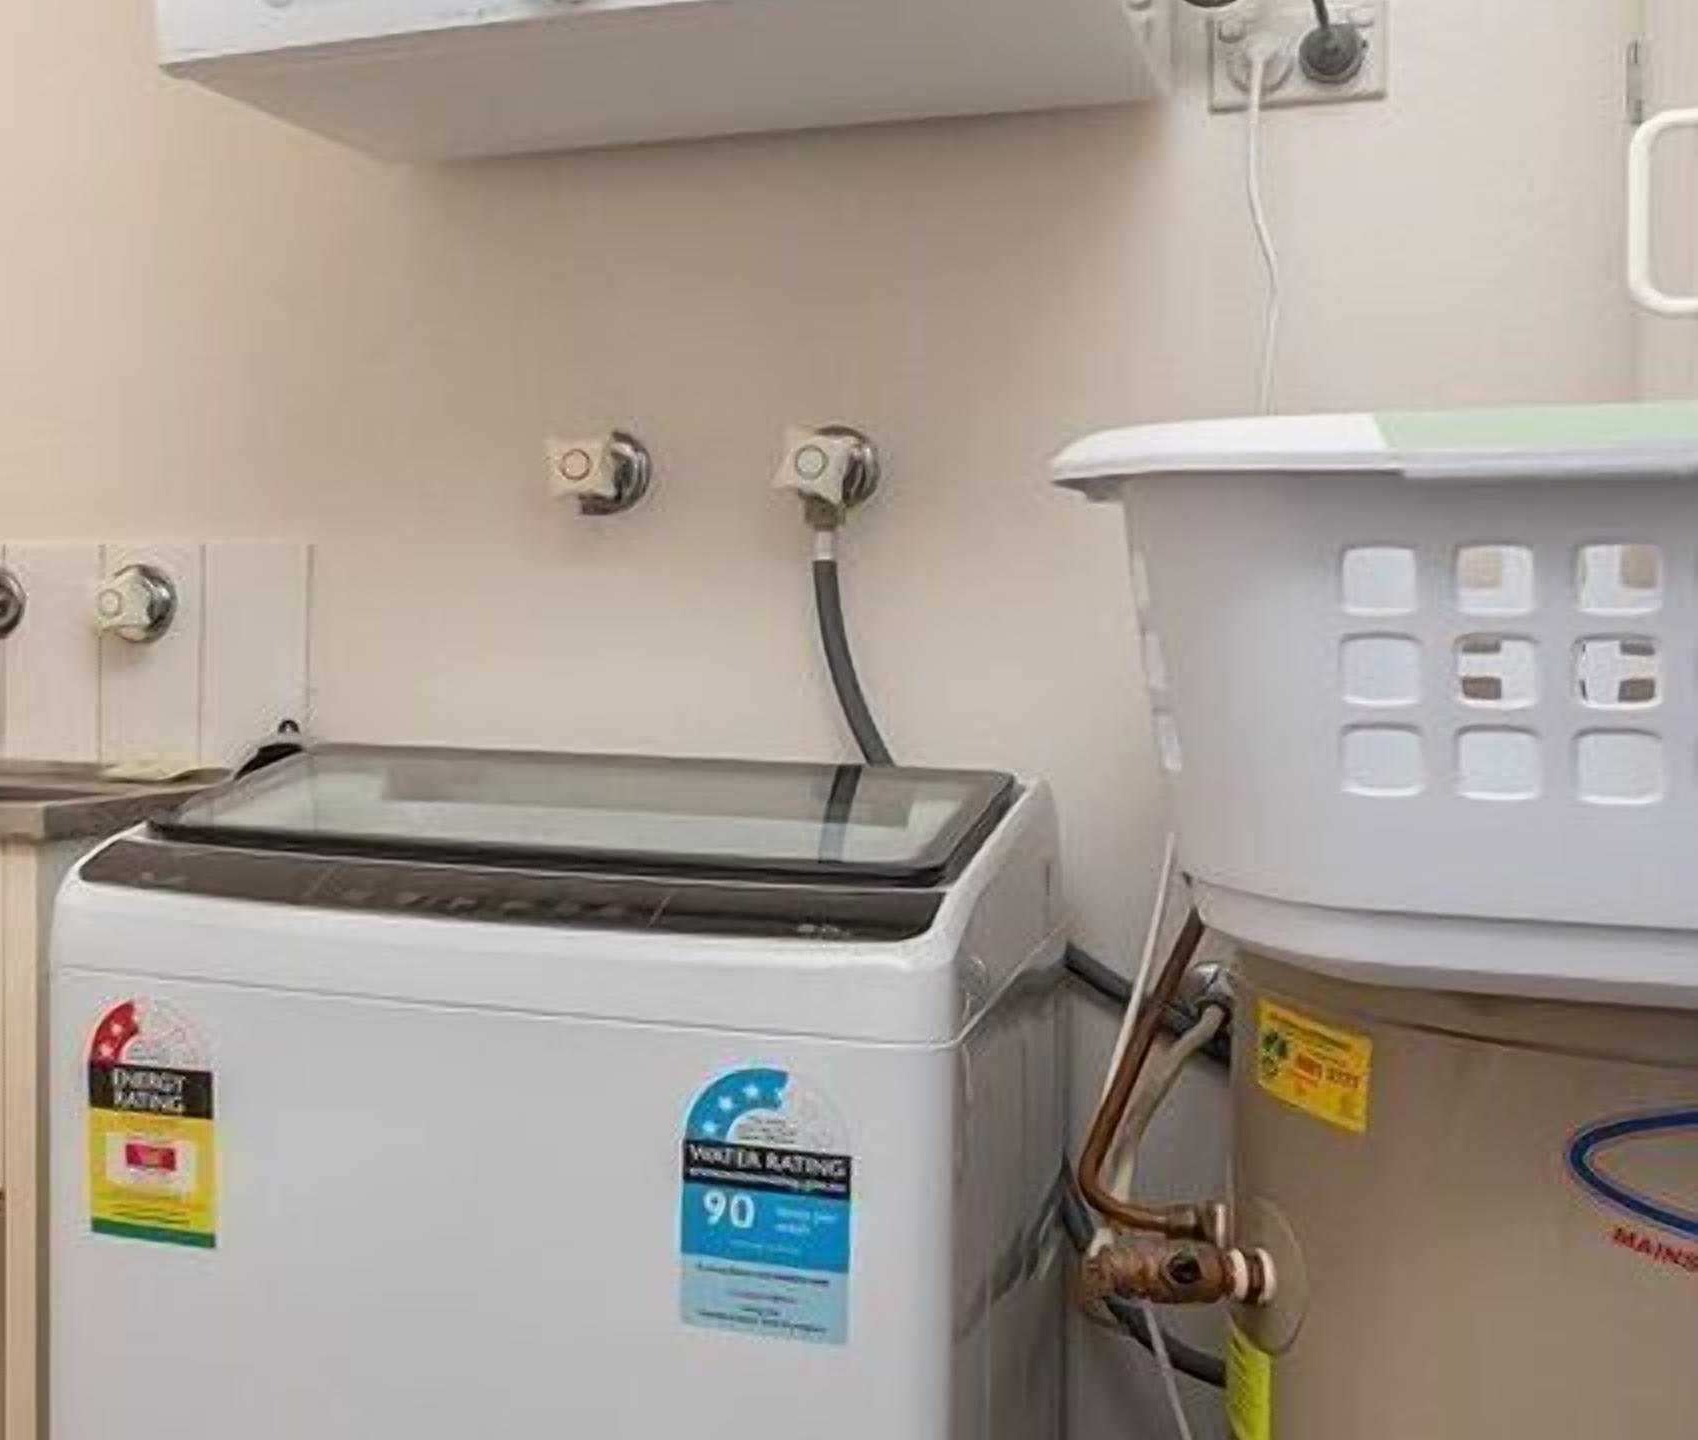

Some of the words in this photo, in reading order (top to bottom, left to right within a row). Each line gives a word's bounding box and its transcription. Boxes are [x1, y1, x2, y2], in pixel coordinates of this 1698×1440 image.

[113, 1068, 186, 1092] ENERGY
[112, 1090, 186, 1114] RATING
[689, 1142, 763, 1170] WATER
[765, 1150, 847, 1177] RATING
[702, 1190, 756, 1229] 90
